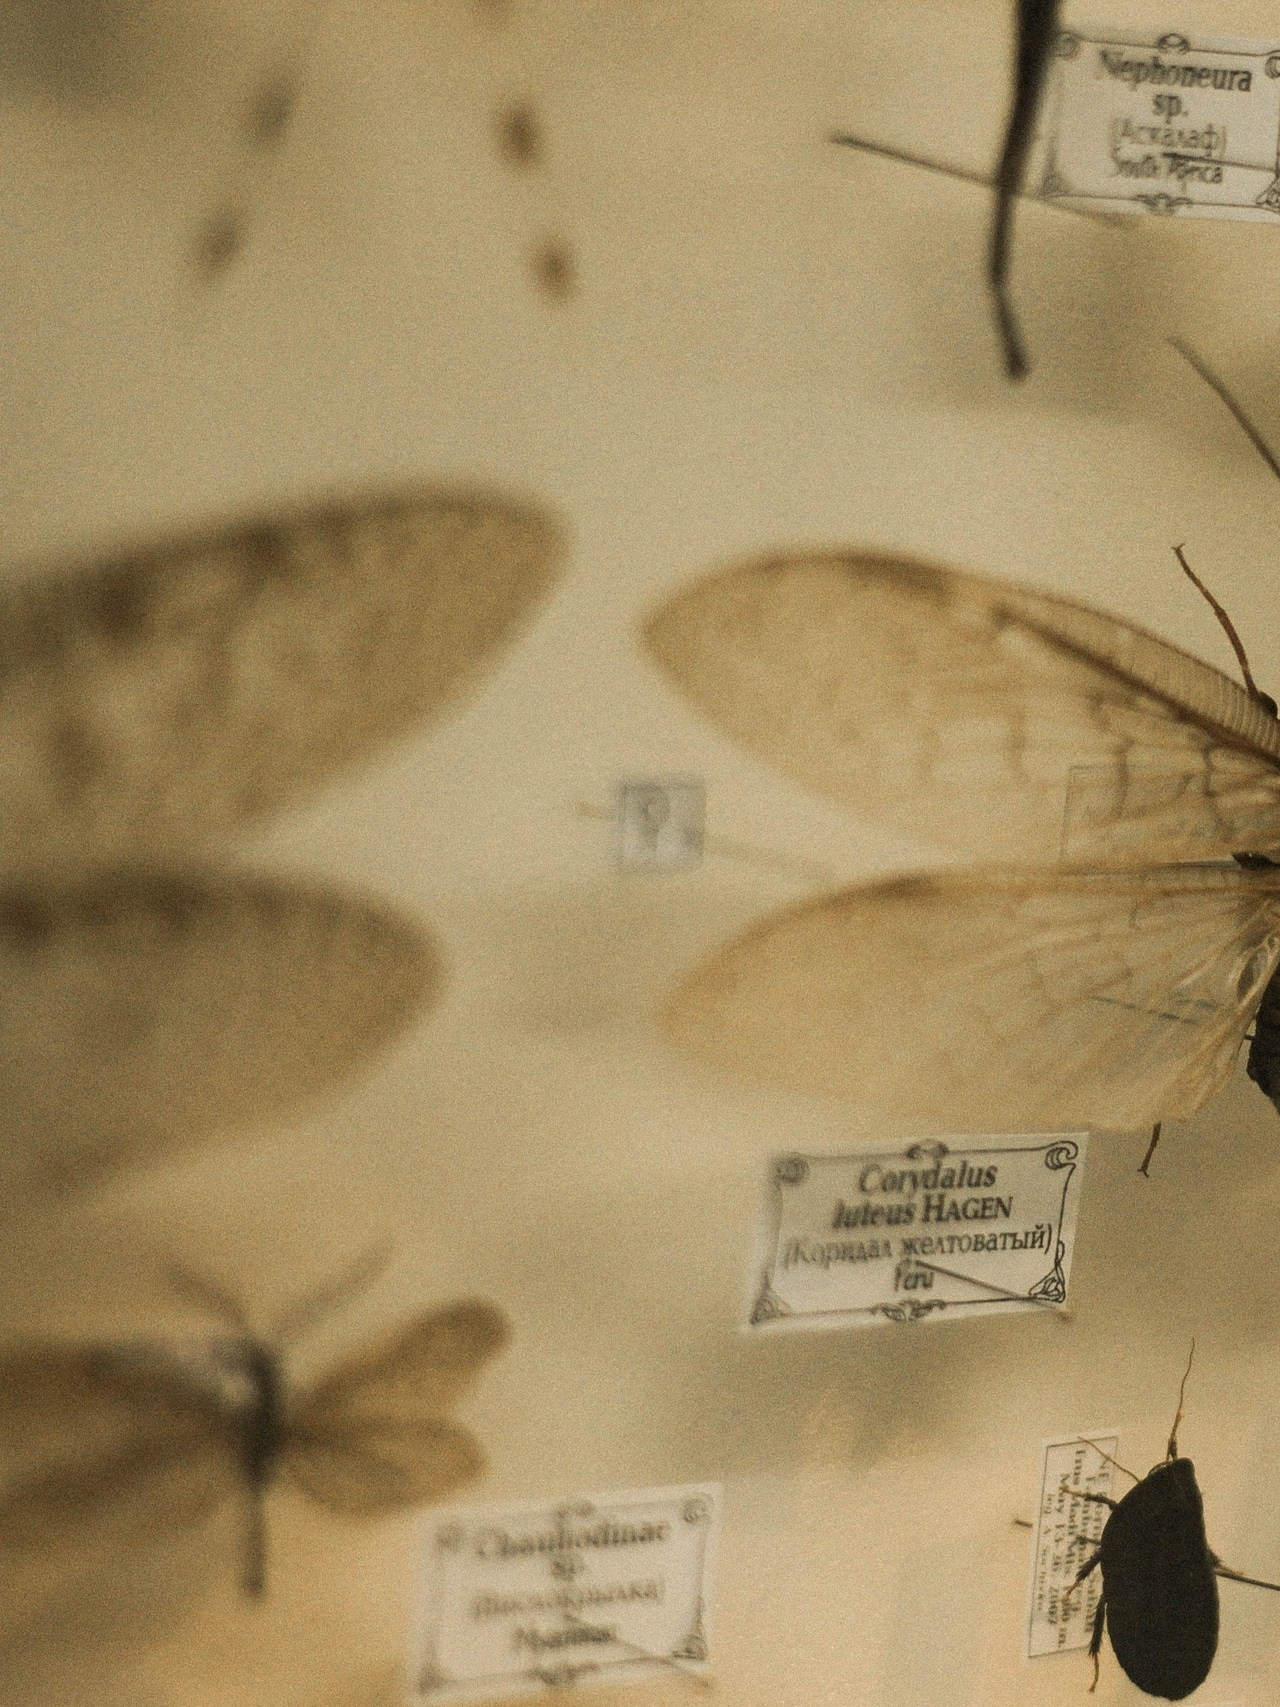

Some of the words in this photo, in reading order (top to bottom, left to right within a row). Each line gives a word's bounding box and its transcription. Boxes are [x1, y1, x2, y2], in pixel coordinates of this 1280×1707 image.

[1100, 50, 1252, 92] Nephoneura
[1152, 94, 1189, 124] sp.
[858, 1160, 998, 1197] Corydalus
[831, 1200, 916, 1229] luteus
[922, 1194, 1013, 1222] HAGEN
[901, 1224, 1053, 1257] желтоватый)
